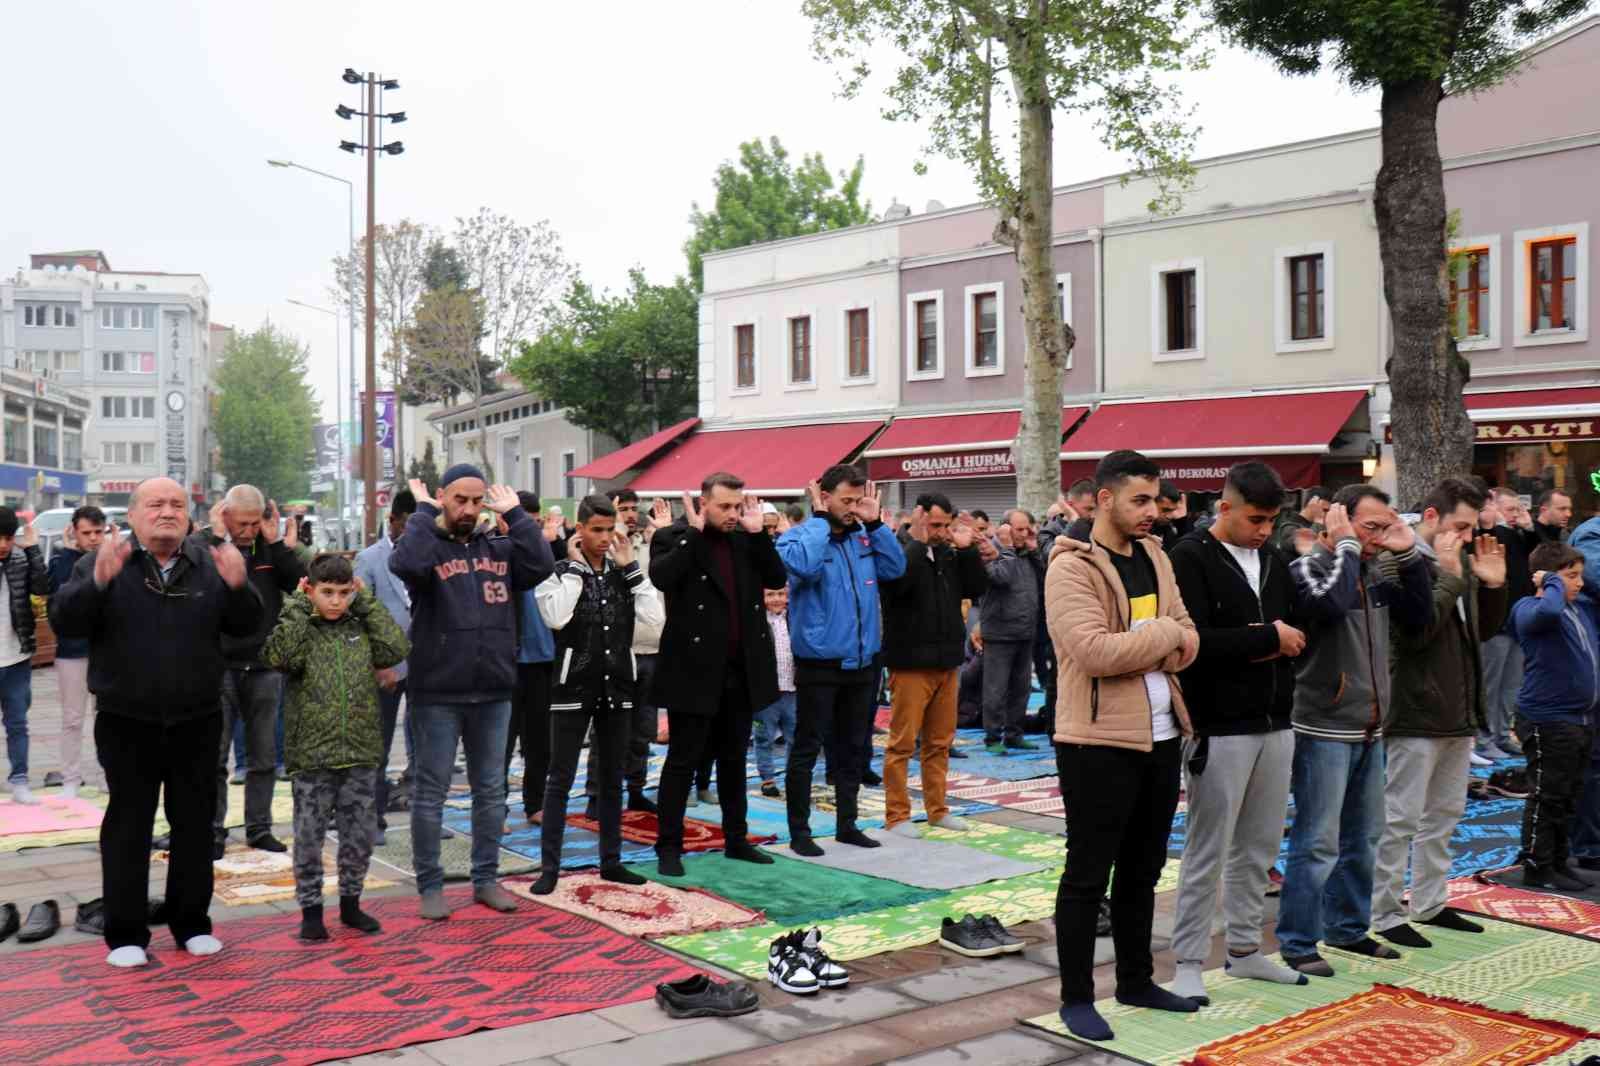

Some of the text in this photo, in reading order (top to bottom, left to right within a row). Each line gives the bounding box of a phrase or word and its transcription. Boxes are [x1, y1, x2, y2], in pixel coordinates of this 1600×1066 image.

[1476, 422, 1594, 438] RALTI
[902, 453, 1015, 471] OSMANLI HURMA
[483, 581, 508, 604] 63
